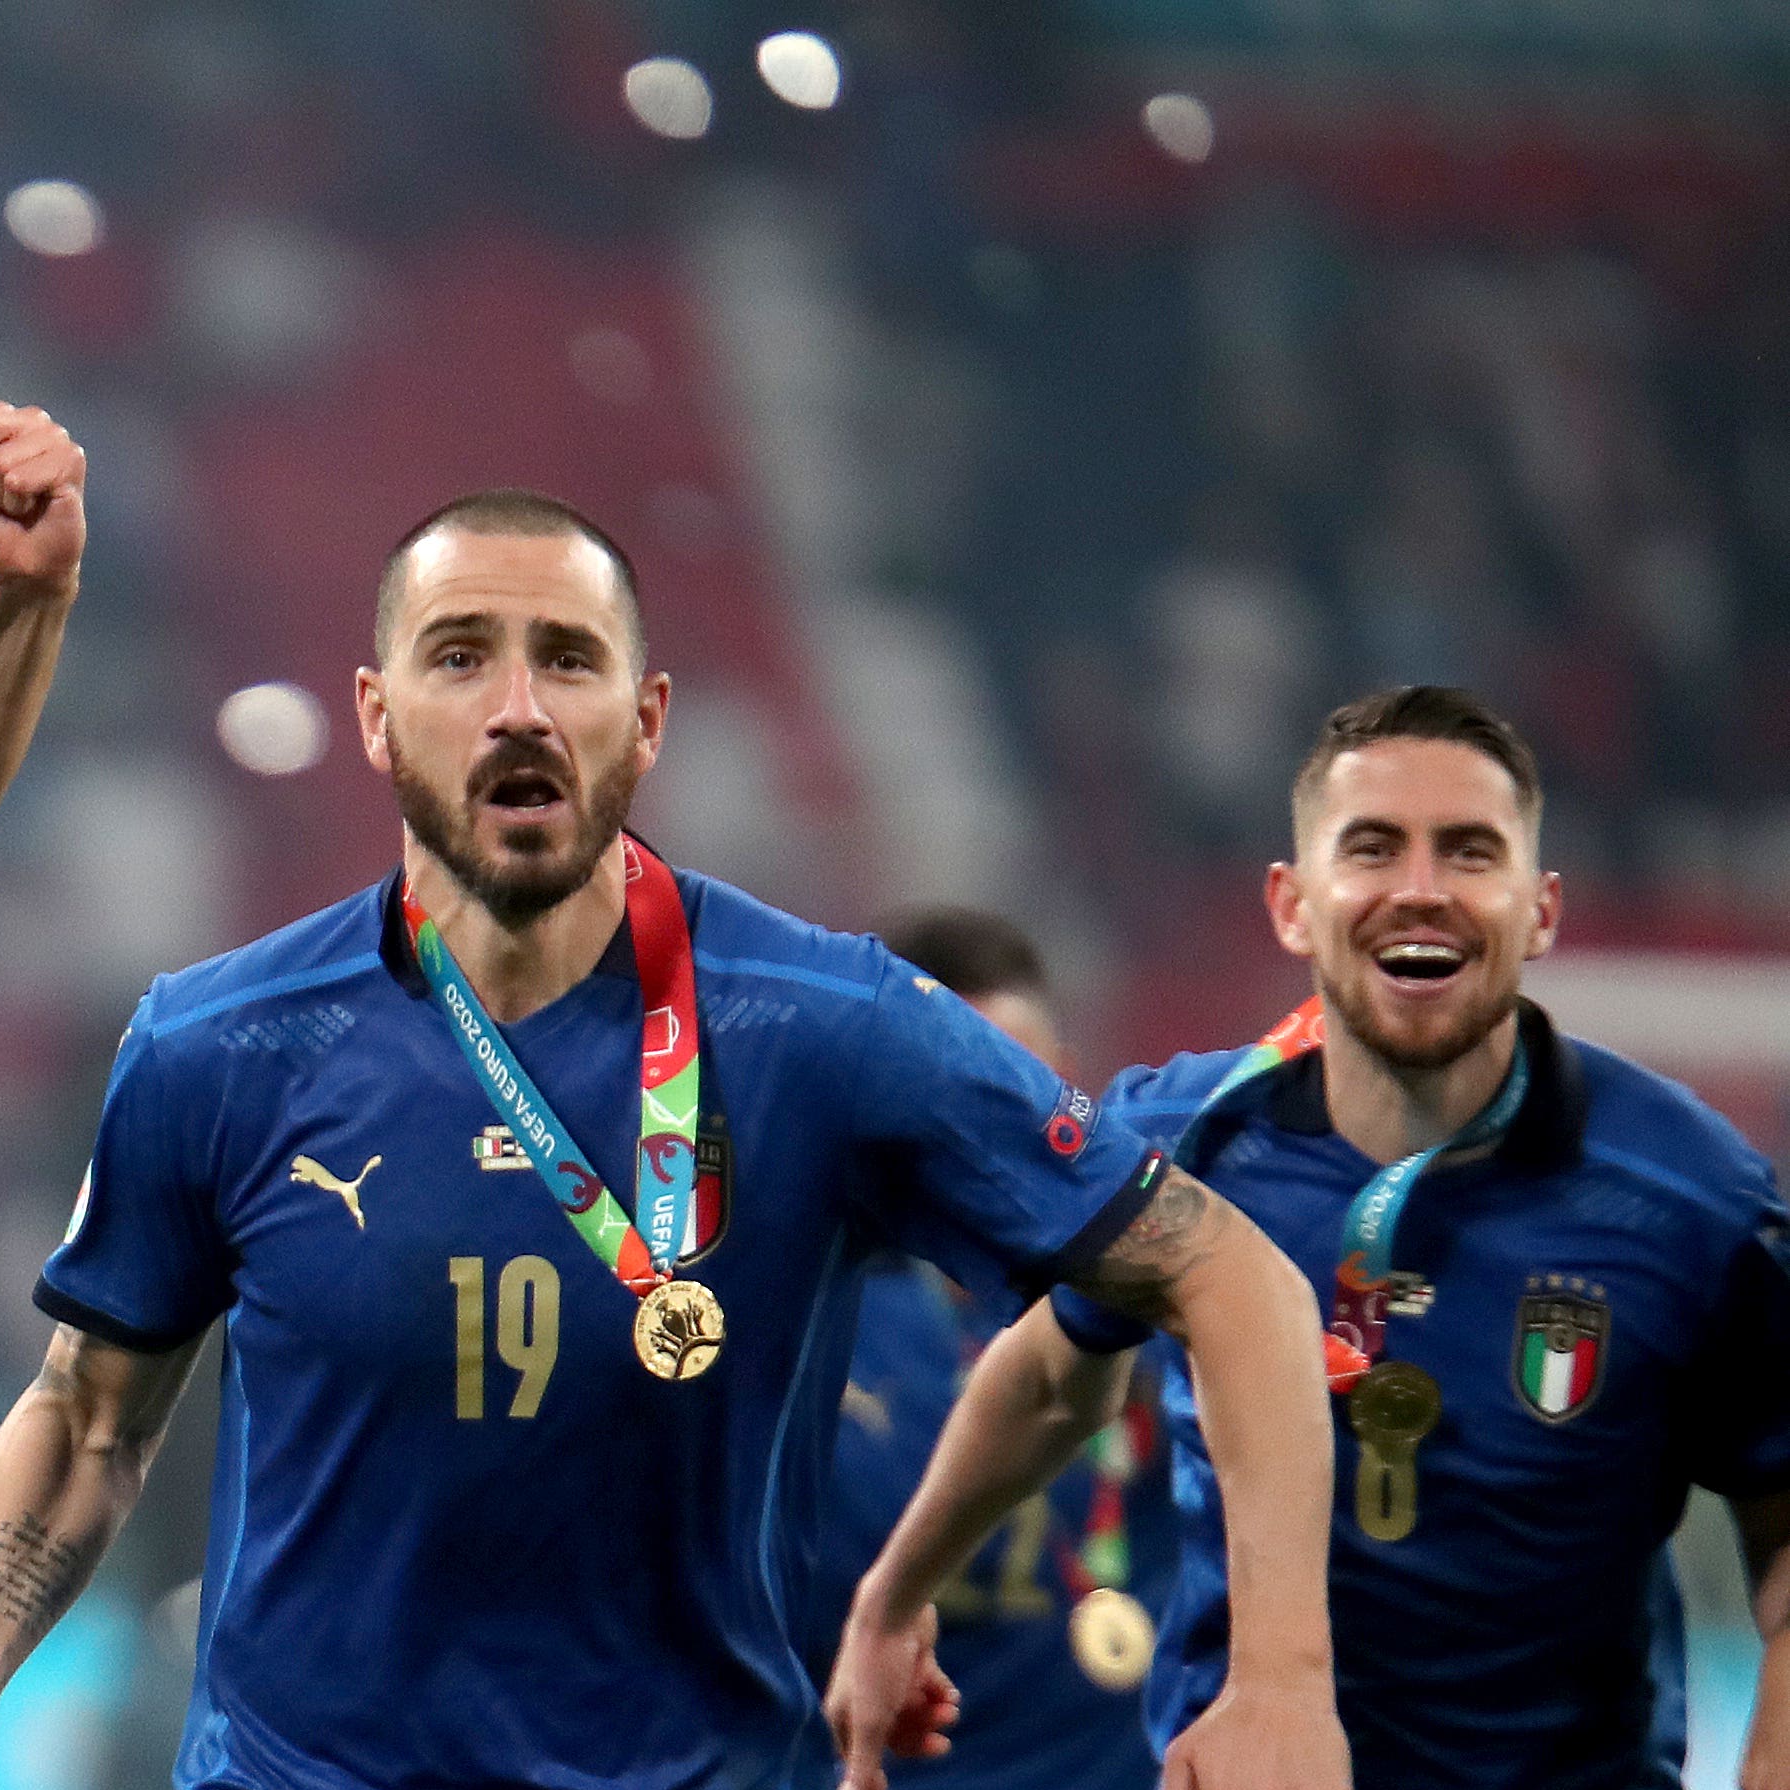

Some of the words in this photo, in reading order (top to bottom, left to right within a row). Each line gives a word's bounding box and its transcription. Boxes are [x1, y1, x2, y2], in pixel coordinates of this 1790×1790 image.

[444, 983, 482, 1043] 2020
[477, 1036, 518, 1102] EURO
[515, 1090, 556, 1159] UEFA
[651, 1195, 673, 1254] UEFA
[449, 1254, 561, 1420] 19
